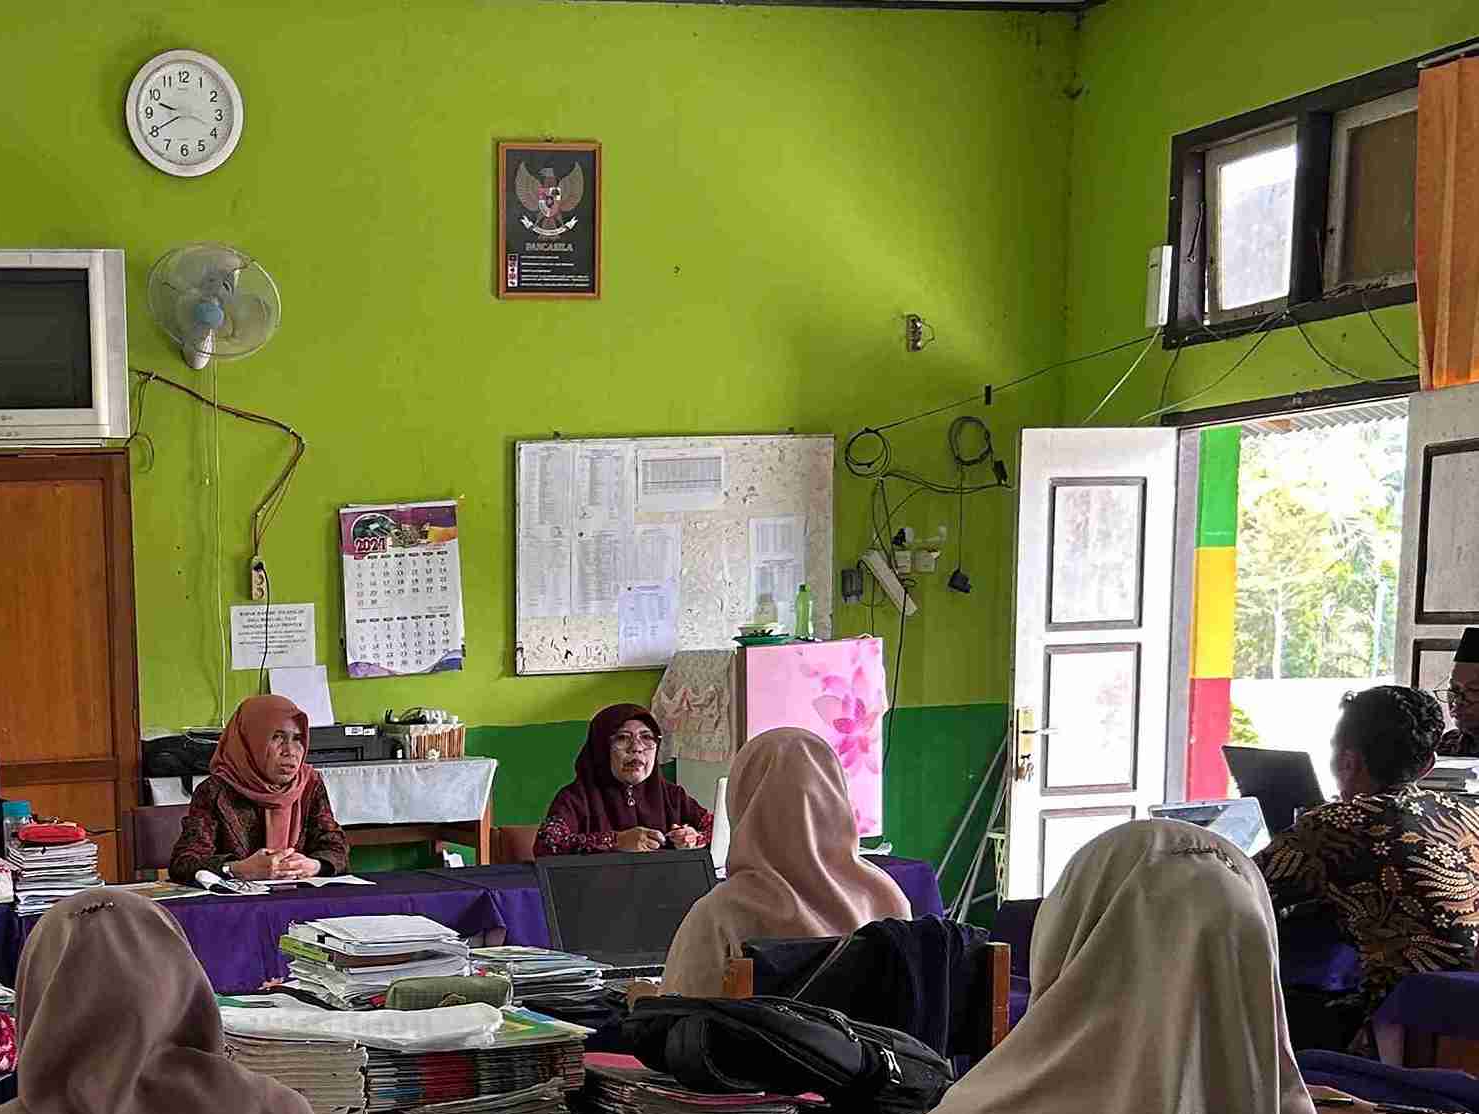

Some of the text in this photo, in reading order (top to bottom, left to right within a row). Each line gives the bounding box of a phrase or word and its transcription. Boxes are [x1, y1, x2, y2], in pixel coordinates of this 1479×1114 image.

[163, 76, 172, 88] 11
[178, 71, 190, 83] 12
[149, 88, 161, 101] 10
[209, 90, 218, 103] 2
[145, 106, 154, 119] 9
[214, 109, 223, 121] 3
[149, 125, 159, 138] 8
[209, 128, 218, 139] 4
[163, 139, 172, 151] 7
[180, 144, 189, 157] 6
[197, 140, 206, 152] 5
